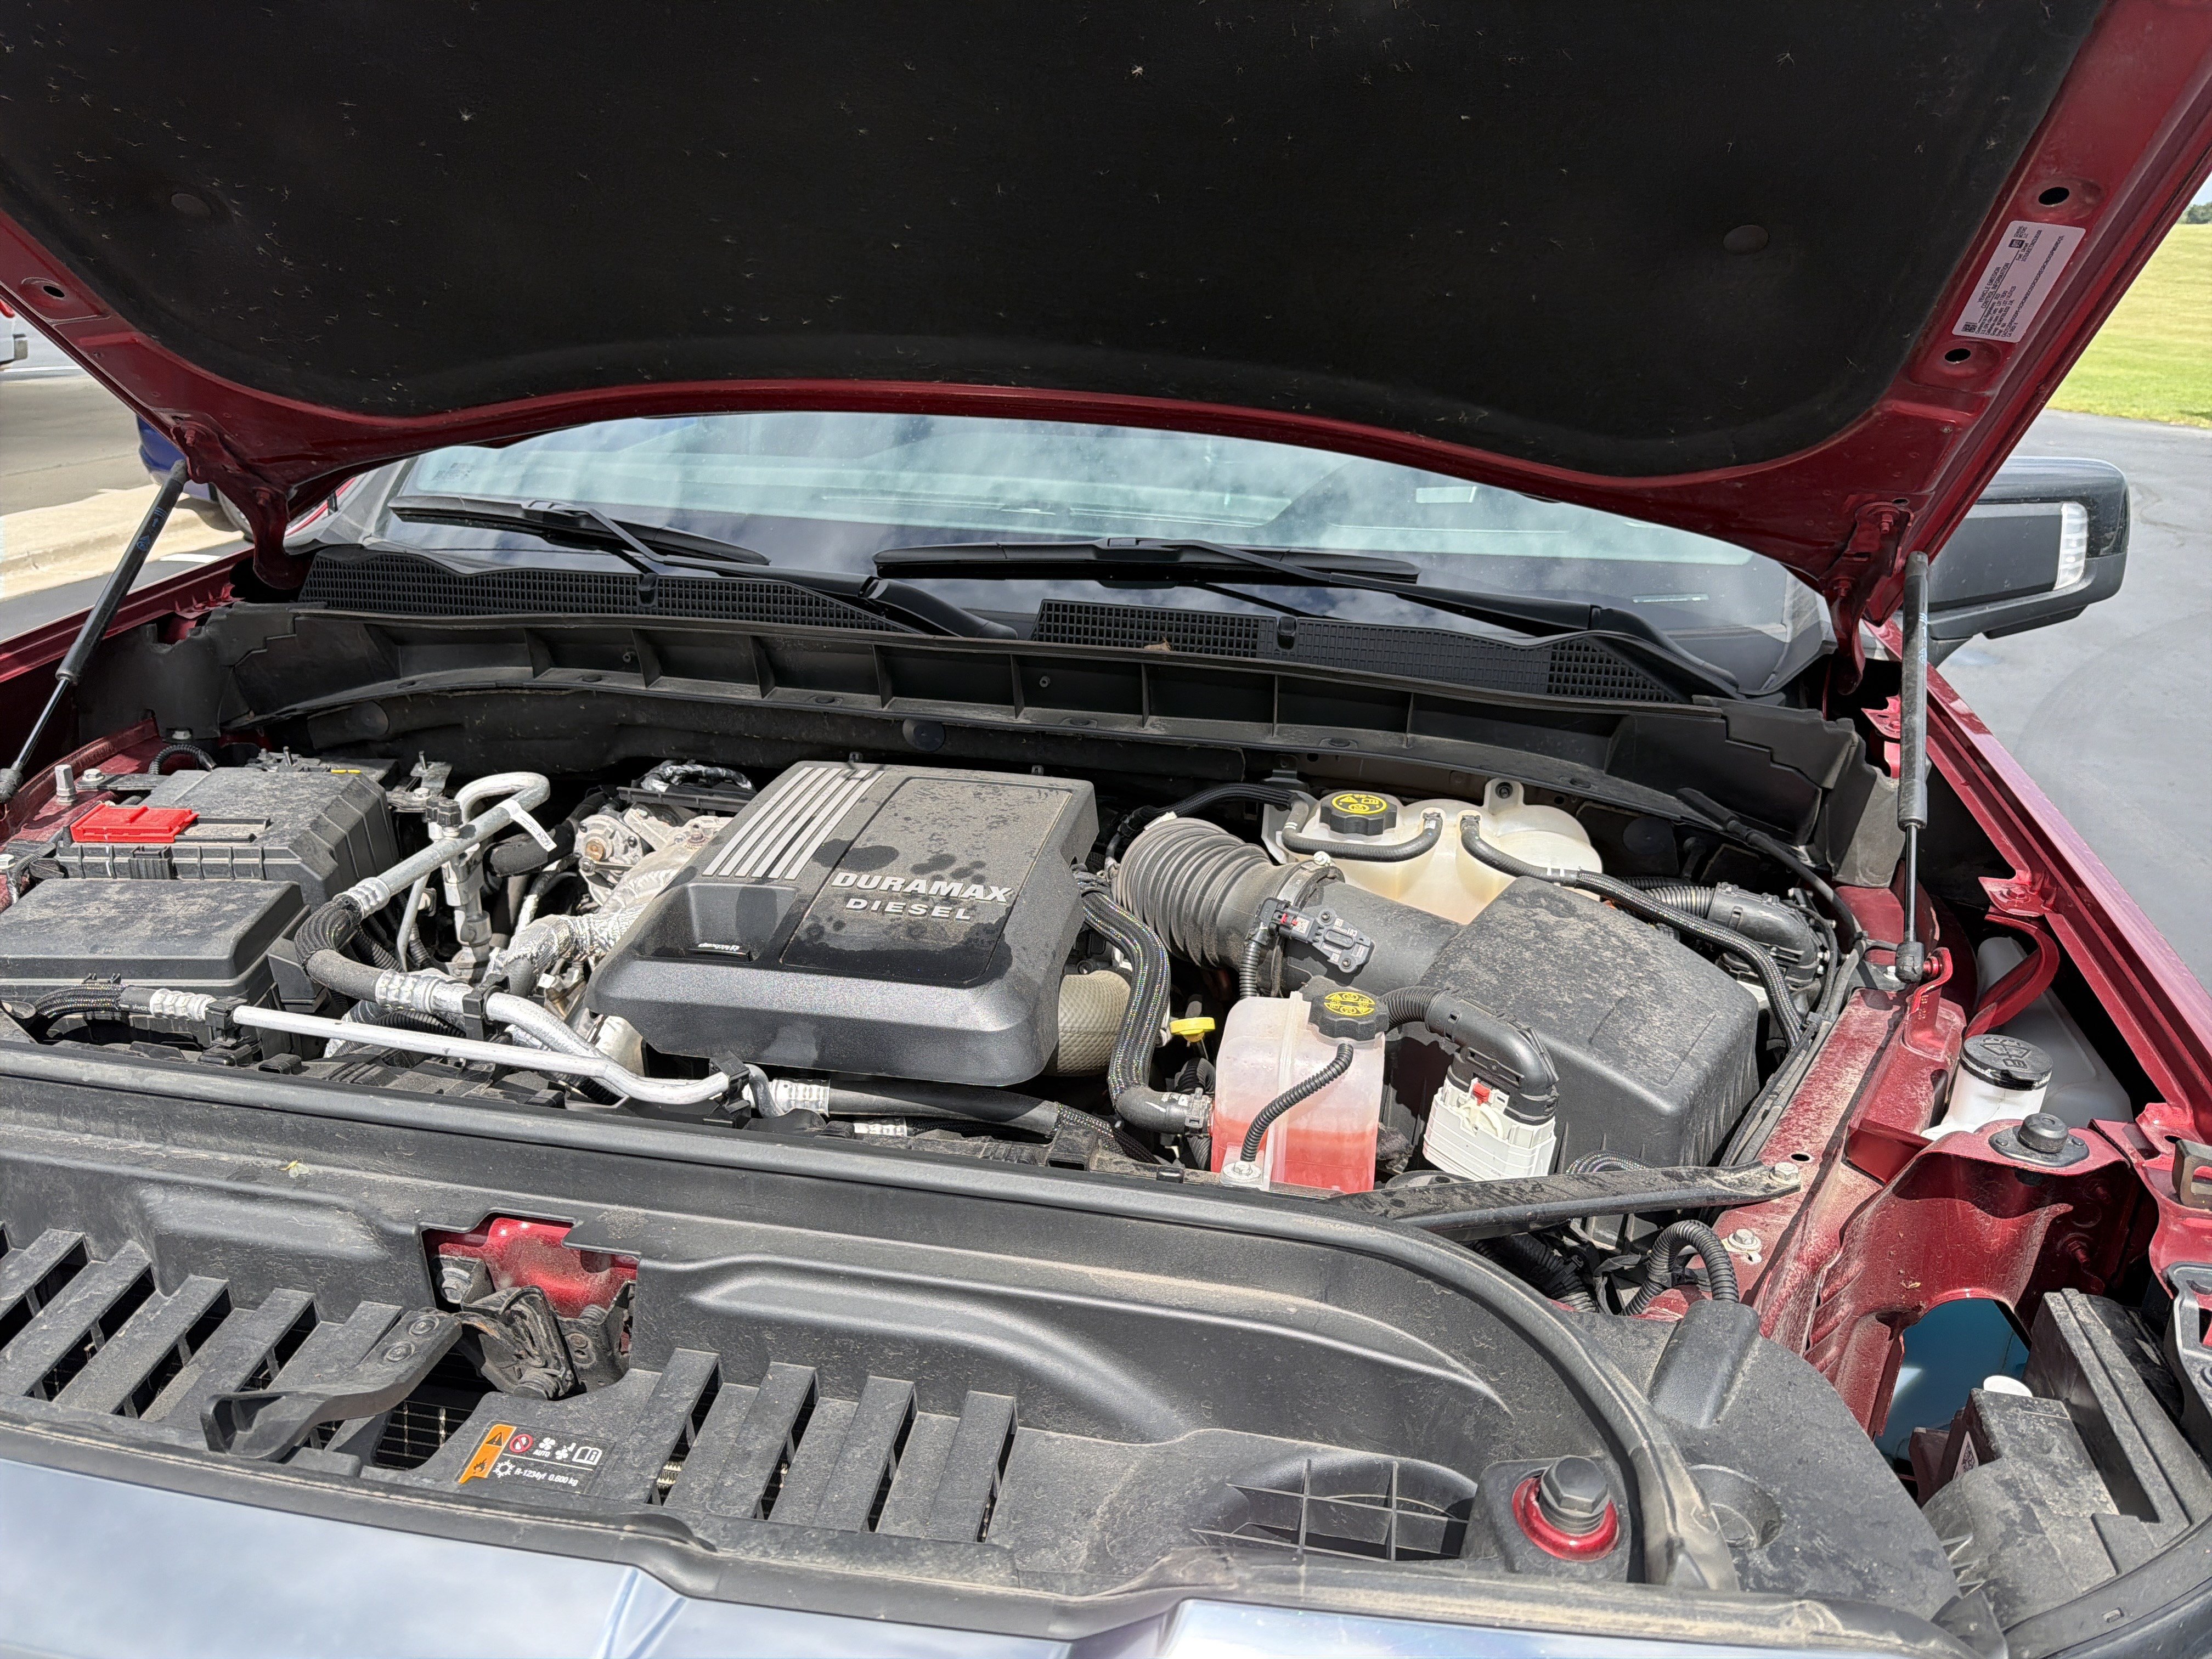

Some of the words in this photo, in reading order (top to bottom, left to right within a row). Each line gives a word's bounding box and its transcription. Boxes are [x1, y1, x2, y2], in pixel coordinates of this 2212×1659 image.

[1977, 286, 1990, 302] VEHICLE
[1987, 267, 2001, 285] EMISSION
[1980, 290, 1995, 308] CONTROL
[1991, 263, 2010, 289] INFORMATION
[831, 872, 1012, 902] DURAMAX
[846, 898, 971, 920] DIESEL
[533, 1449, 551, 1458] AUTO
[514, 1468, 548, 1480] R-1234yf
[548, 1474, 569, 1483] 0.600
[568, 1477, 579, 1487] kg
